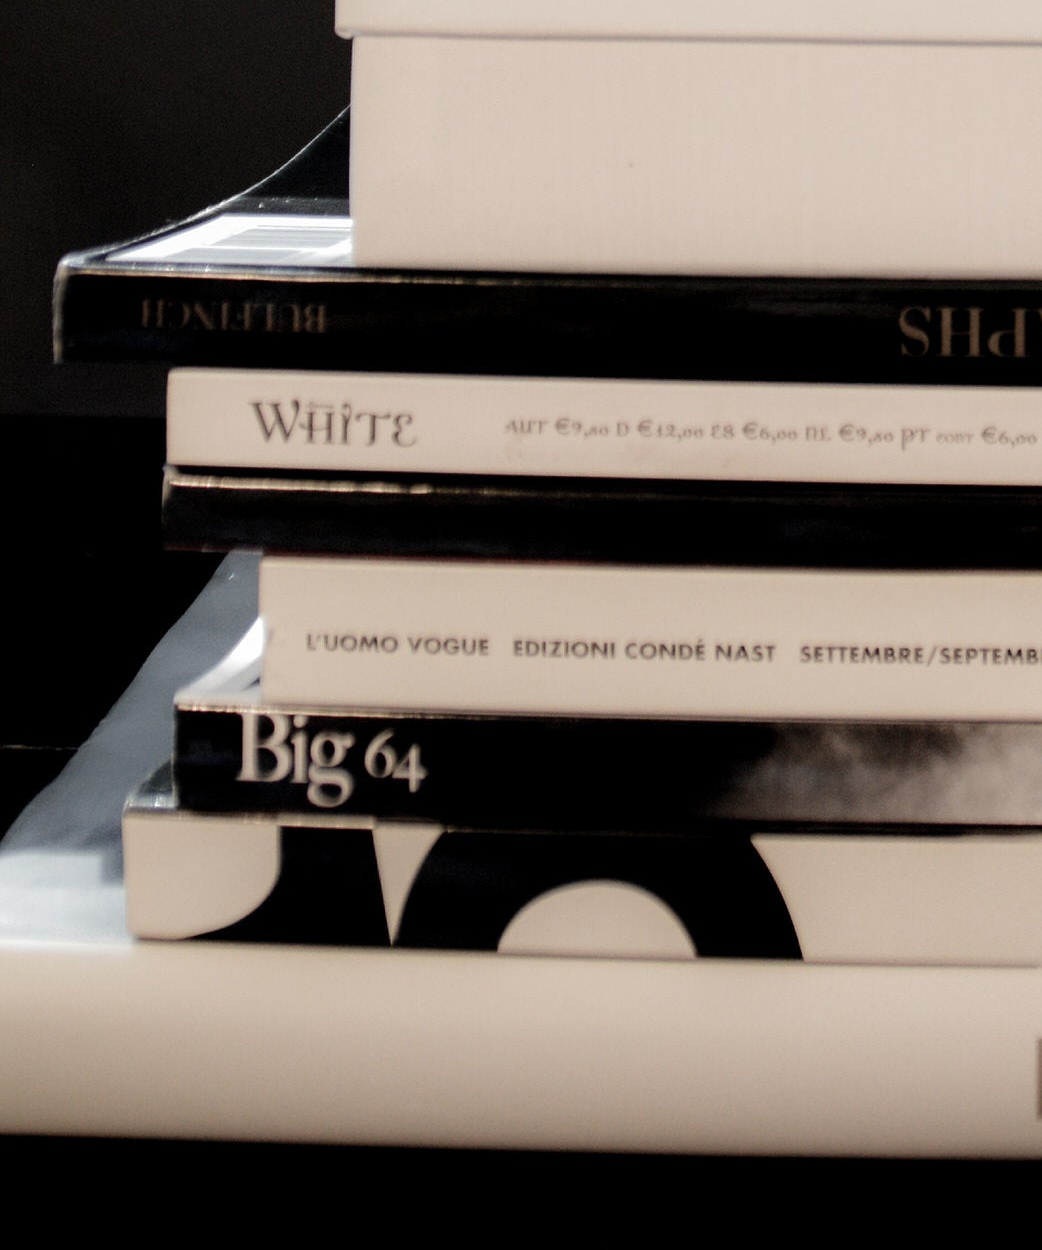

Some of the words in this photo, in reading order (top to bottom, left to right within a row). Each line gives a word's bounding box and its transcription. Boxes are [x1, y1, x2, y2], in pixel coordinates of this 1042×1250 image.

[142, 298, 328, 335] BULFINCH
[250, 398, 418, 448] WHITE
[616, 422, 630, 438] D
[306, 633, 400, 654] L'UOMO
[407, 637, 490, 657] VOGUE
[513, 639, 617, 659] EDIZIONI
[624, 637, 706, 662] CONDÉ
[714, 644, 776, 664] NAST
[235, 713, 354, 808] Big
[364, 728, 428, 794] 64
